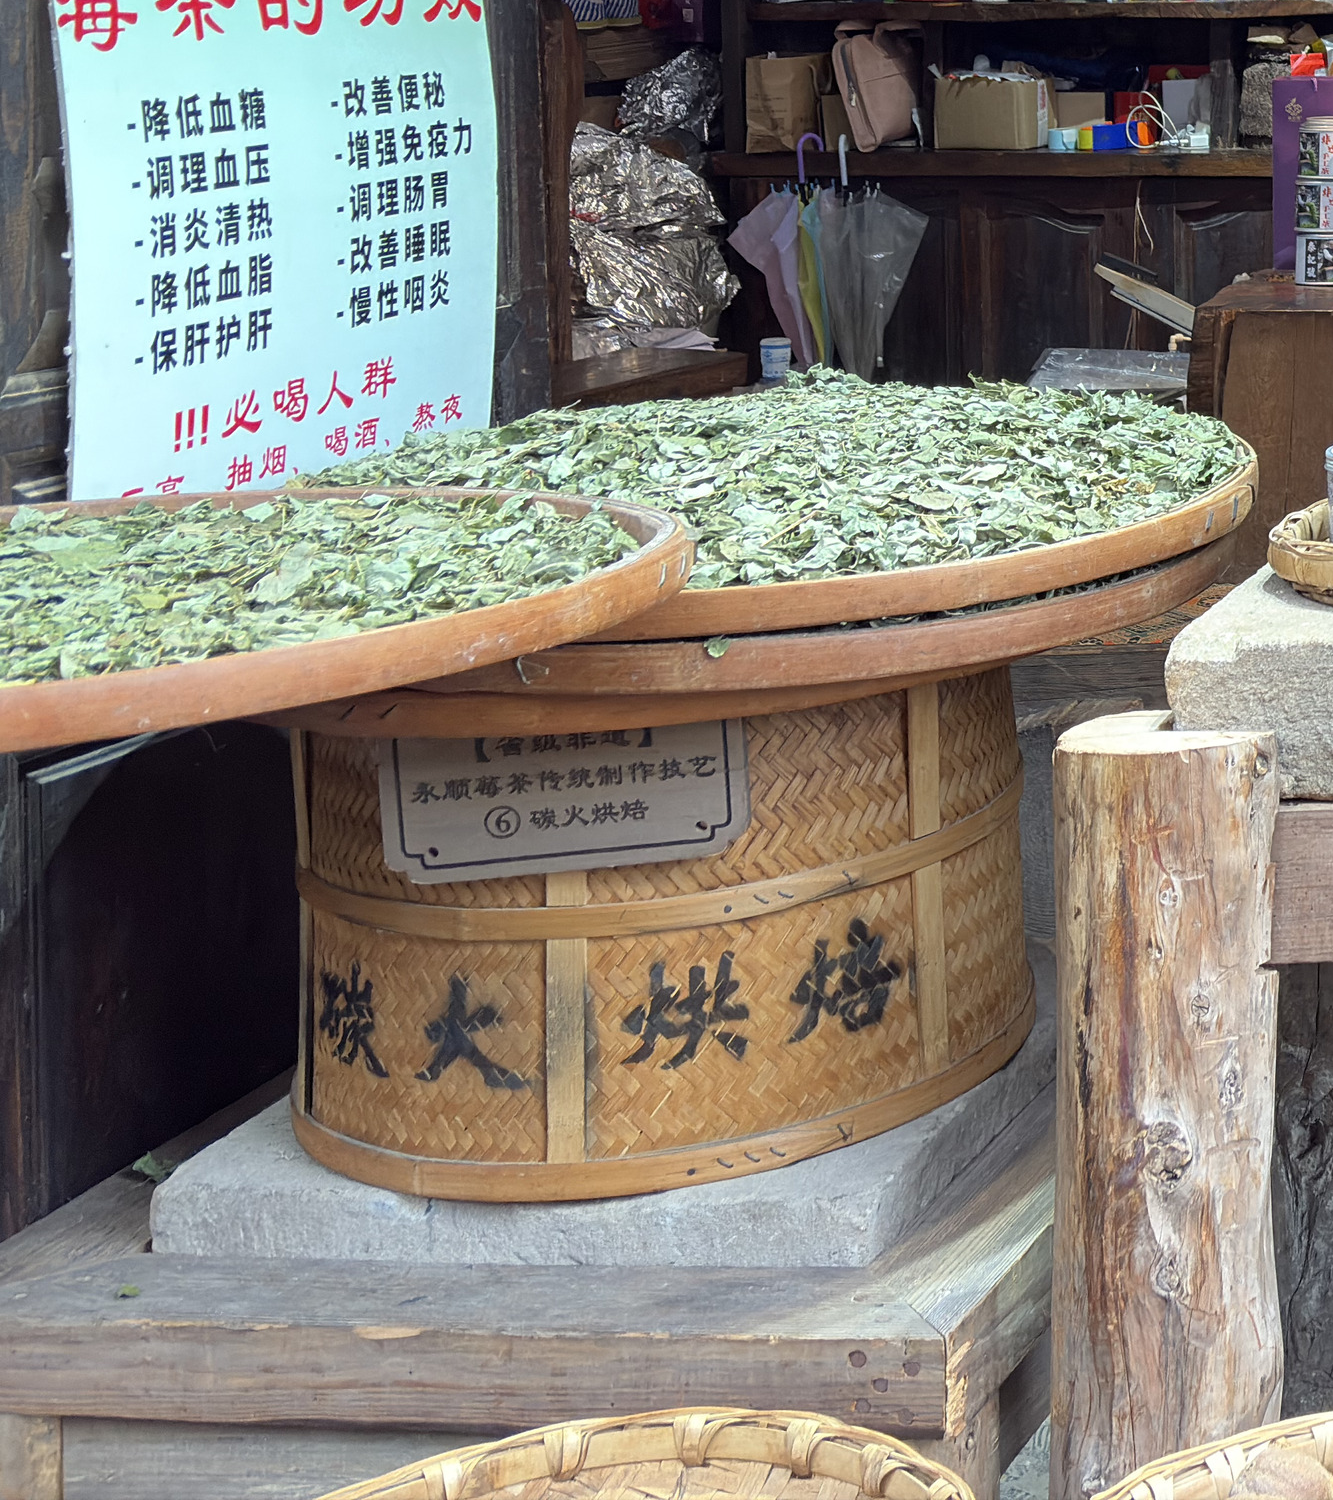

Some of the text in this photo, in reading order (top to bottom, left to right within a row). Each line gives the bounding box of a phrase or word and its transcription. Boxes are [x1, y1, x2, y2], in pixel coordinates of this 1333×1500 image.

[411, 755, 718, 804] 永顺莓茶传统制作技艺
